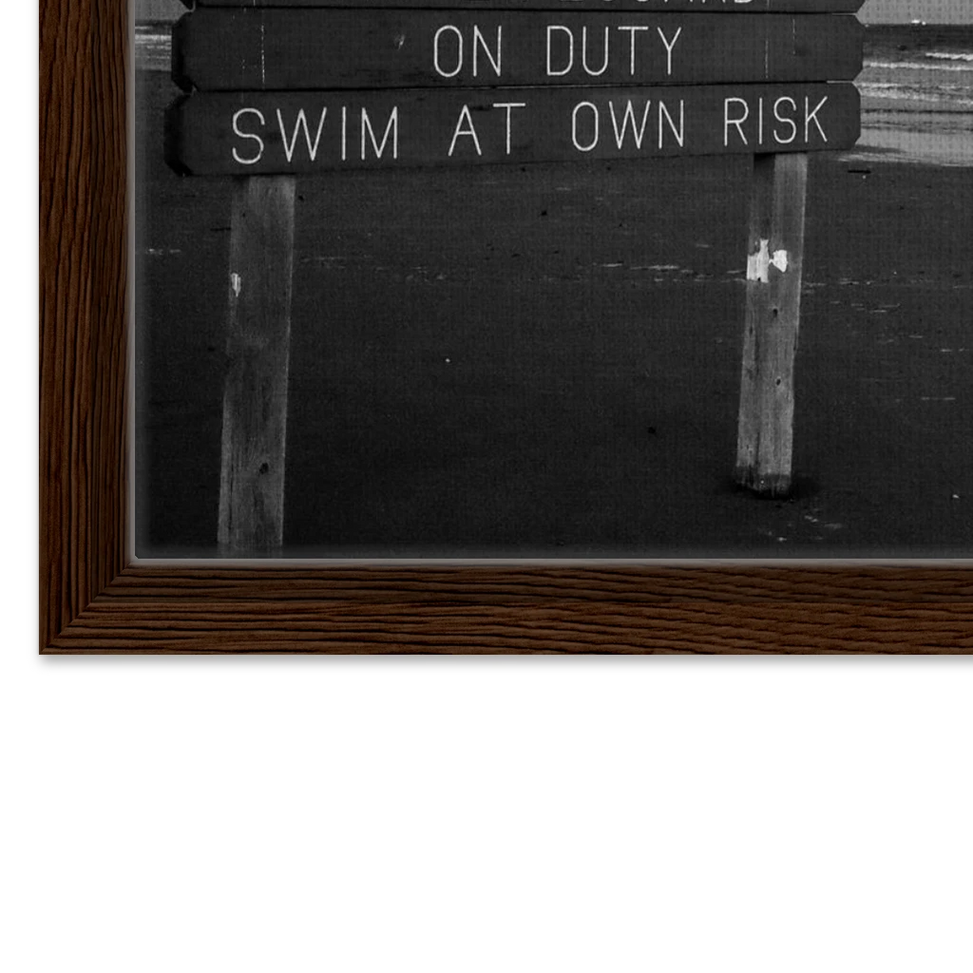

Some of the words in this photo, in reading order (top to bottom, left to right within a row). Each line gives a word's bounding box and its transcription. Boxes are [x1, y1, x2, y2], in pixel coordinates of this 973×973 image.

[433, 24, 502, 77] ON
[546, 25, 682, 76] DUTY
[232, 106, 399, 165] SWIM
[447, 103, 527, 157] AT
[571, 100, 685, 152] OWN
[723, 95, 828, 147] RISK
